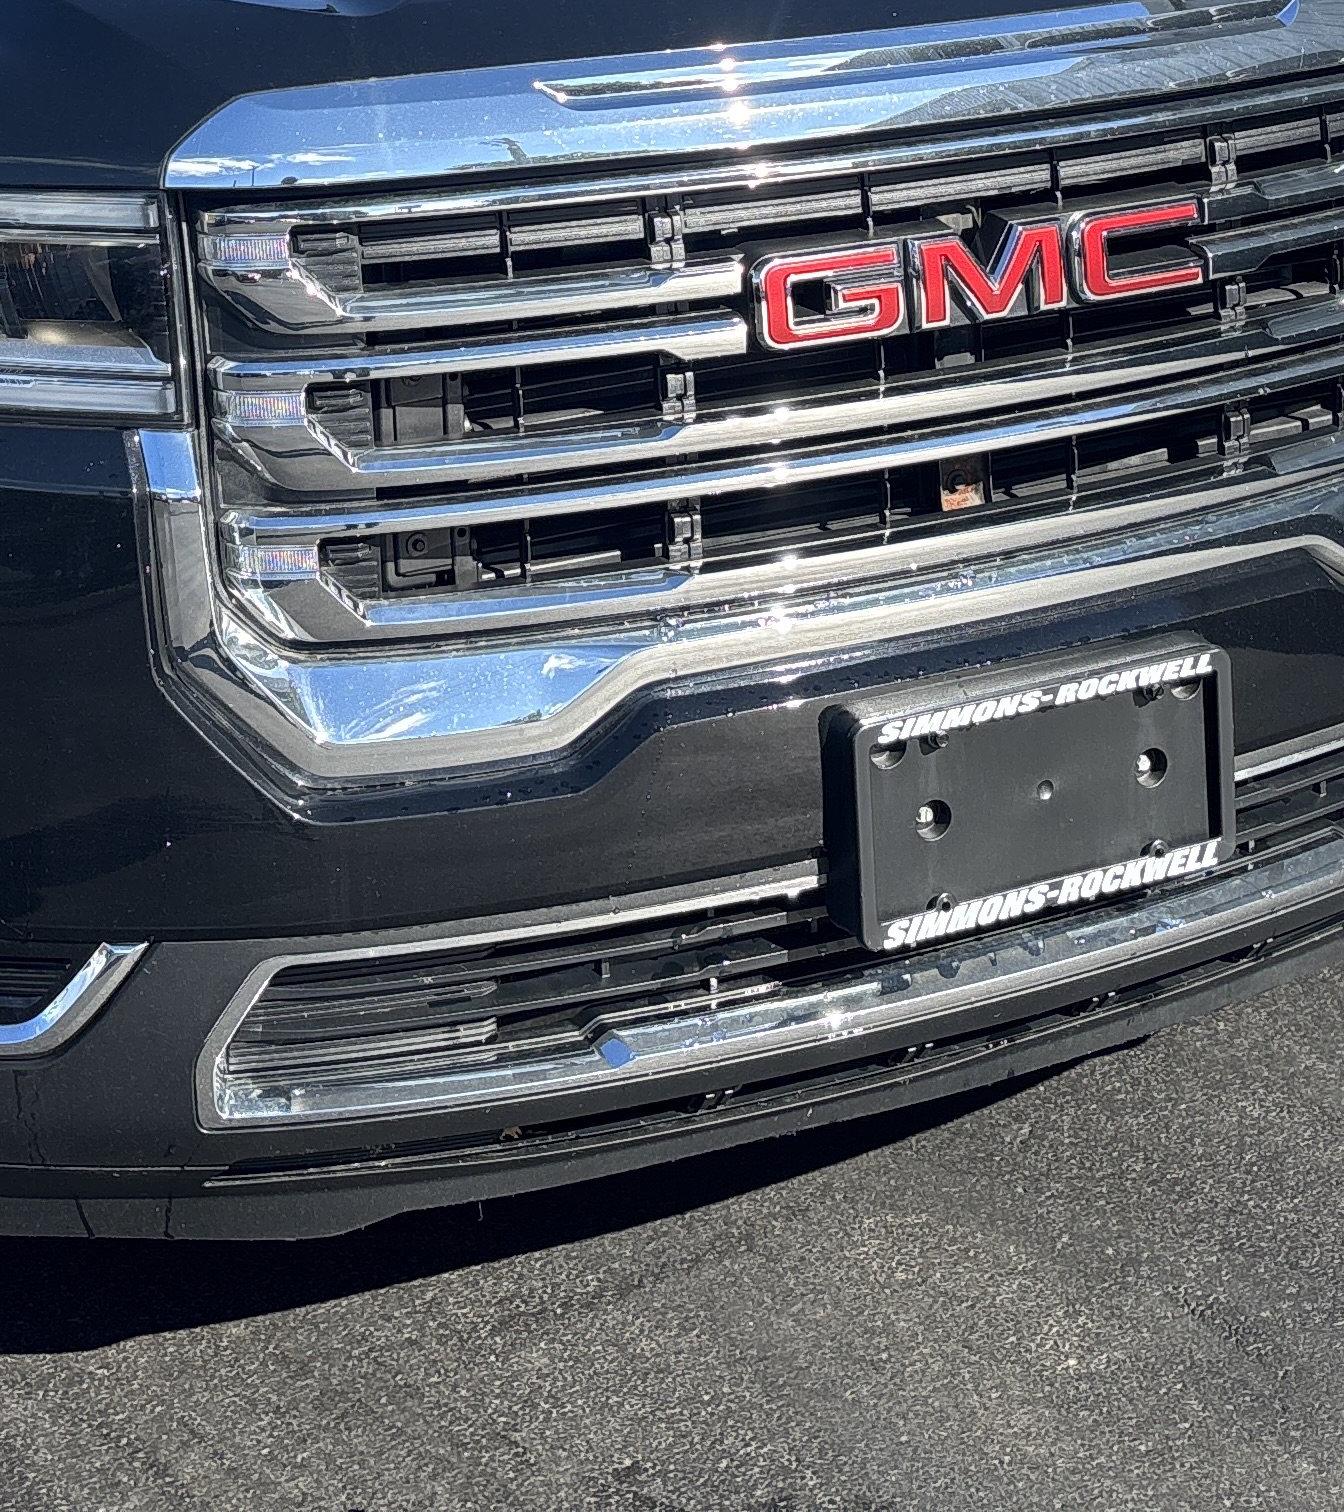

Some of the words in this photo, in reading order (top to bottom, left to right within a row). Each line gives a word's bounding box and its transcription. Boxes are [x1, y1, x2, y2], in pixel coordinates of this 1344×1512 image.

[751, 193, 1208, 352] GMC
[877, 653, 1214, 745] SIMMONS-ROCKWELL
[882, 839, 1222, 951] SIMMONS-ROCKWELL
